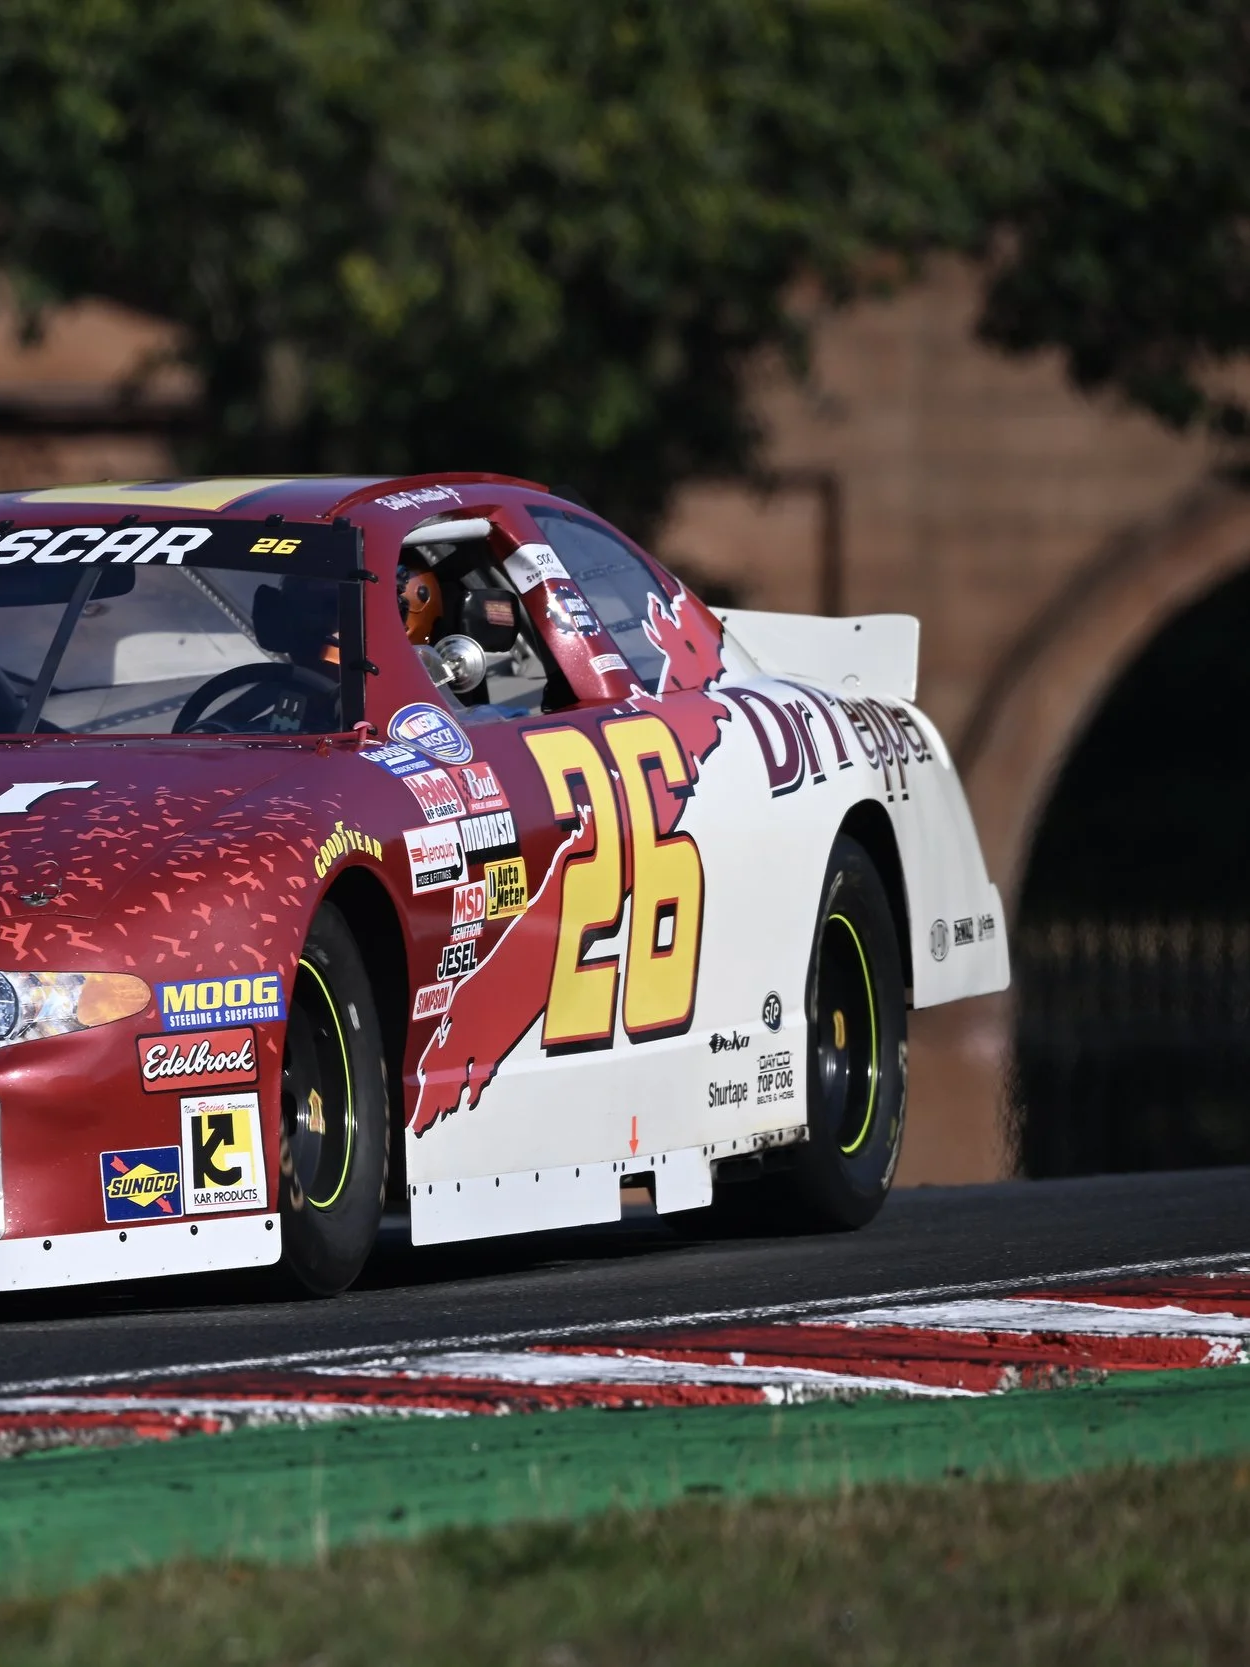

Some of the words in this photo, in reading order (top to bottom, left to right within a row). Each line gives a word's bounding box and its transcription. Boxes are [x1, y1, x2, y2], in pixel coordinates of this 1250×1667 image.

[250, 538, 302, 554] 26
[417, 728, 456, 748] BUSCH
[717, 687, 828, 799] Dr
[403, 773, 463, 813] Holley
[461, 766, 501, 800] Bud
[436, 803, 458, 817] CARBS
[460, 811, 517, 853] MOROSO
[314, 820, 383, 879] GOODYEAR
[418, 834, 456, 866] Aeroquip
[498, 864, 519, 887] Auto
[518, 709, 706, 1058] 26
[454, 887, 485, 924] MSD
[498, 885, 525, 907] Meter
[451, 925, 483, 941] IGNITION
[438, 942, 476, 979] JESEL
[163, 976, 277, 1013] MOOG
[416, 986, 450, 1015] SIMPSON
[170, 1012, 212, 1027] STEERING
[216, 1011, 221, 1023] &
[225, 1005, 279, 1022] SUSPENSION
[764, 998, 780, 1024] STP
[142, 1039, 255, 1081] Edelbrock
[757, 1050, 793, 1070] DAYCO
[709, 1080, 748, 1108] Shurtape
[757, 1074, 774, 1093] TOP
[775, 1070, 793, 1090] COG
[197, 1102, 225, 1114] Racing
[111, 1175, 178, 1196] SUNOCO
[194, 1193, 212, 1204] KAR
[214, 1189, 258, 1203] PRODUCTS
